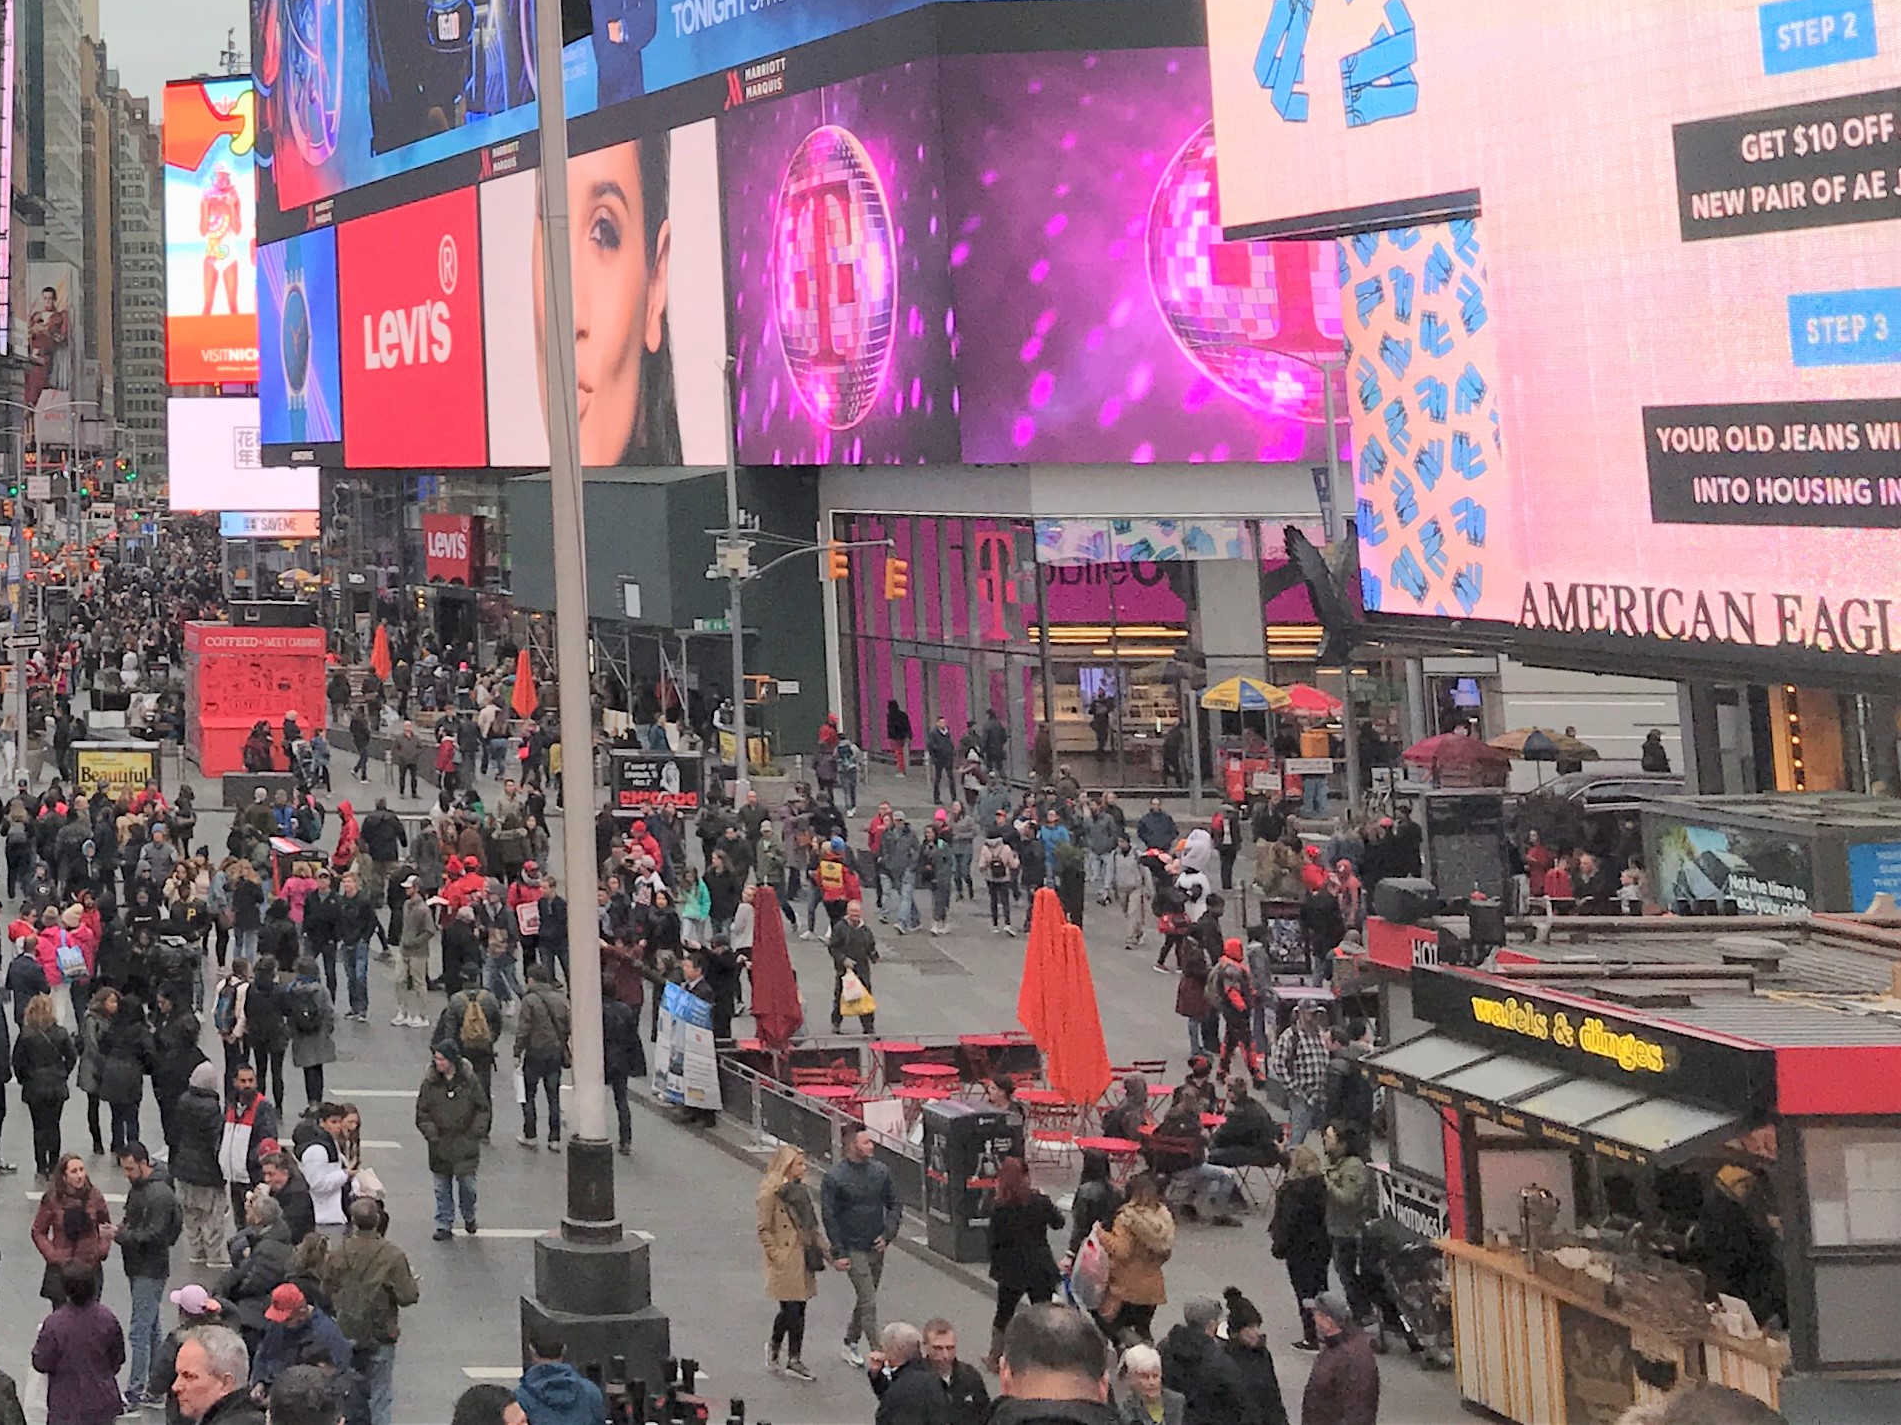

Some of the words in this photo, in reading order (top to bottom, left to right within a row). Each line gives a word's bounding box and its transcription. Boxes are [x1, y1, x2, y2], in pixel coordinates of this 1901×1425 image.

[1777, 15, 1835, 52] STEP
[1842, 12, 1859, 39] 2
[744, 58, 787, 81] MARRIOTT
[744, 78, 783, 100] MARQUIS
[1741, 129, 1787, 162] GET
[1792, 122, 1838, 158] $10
[1842, 113, 1895, 148] OFF
[1691, 187, 1746, 221] NEW
[1751, 181, 1807, 214] PAIR
[1812, 175, 1847, 206] OF
[1853, 171, 1887, 201] AE
[1806, 314, 1867, 345] STEP
[1875, 313, 1889, 342] 3
[1656, 426, 1720, 454] YOUR
[1725, 425, 1775, 453] OLD
[1779, 423, 1859, 452] JEANS
[1693, 477, 1750, 505] INTO
[1755, 477, 1873, 506] HOUSING
[1514, 581, 1756, 645] AMERICAN
[204, 637, 259, 648] COFFEED
[81, 766, 148, 784] Beautiful
[1728, 874, 1748, 890] Not
[1750, 876, 1768, 894] the
[1768, 880, 1792, 899] time
[1793, 884, 1806, 901] to
[1411, 937, 1440, 967] HOT
[1470, 994, 1548, 1042] wafels
[1552, 1013, 1575, 1048] &
[1578, 1016, 1666, 1074] dinges
